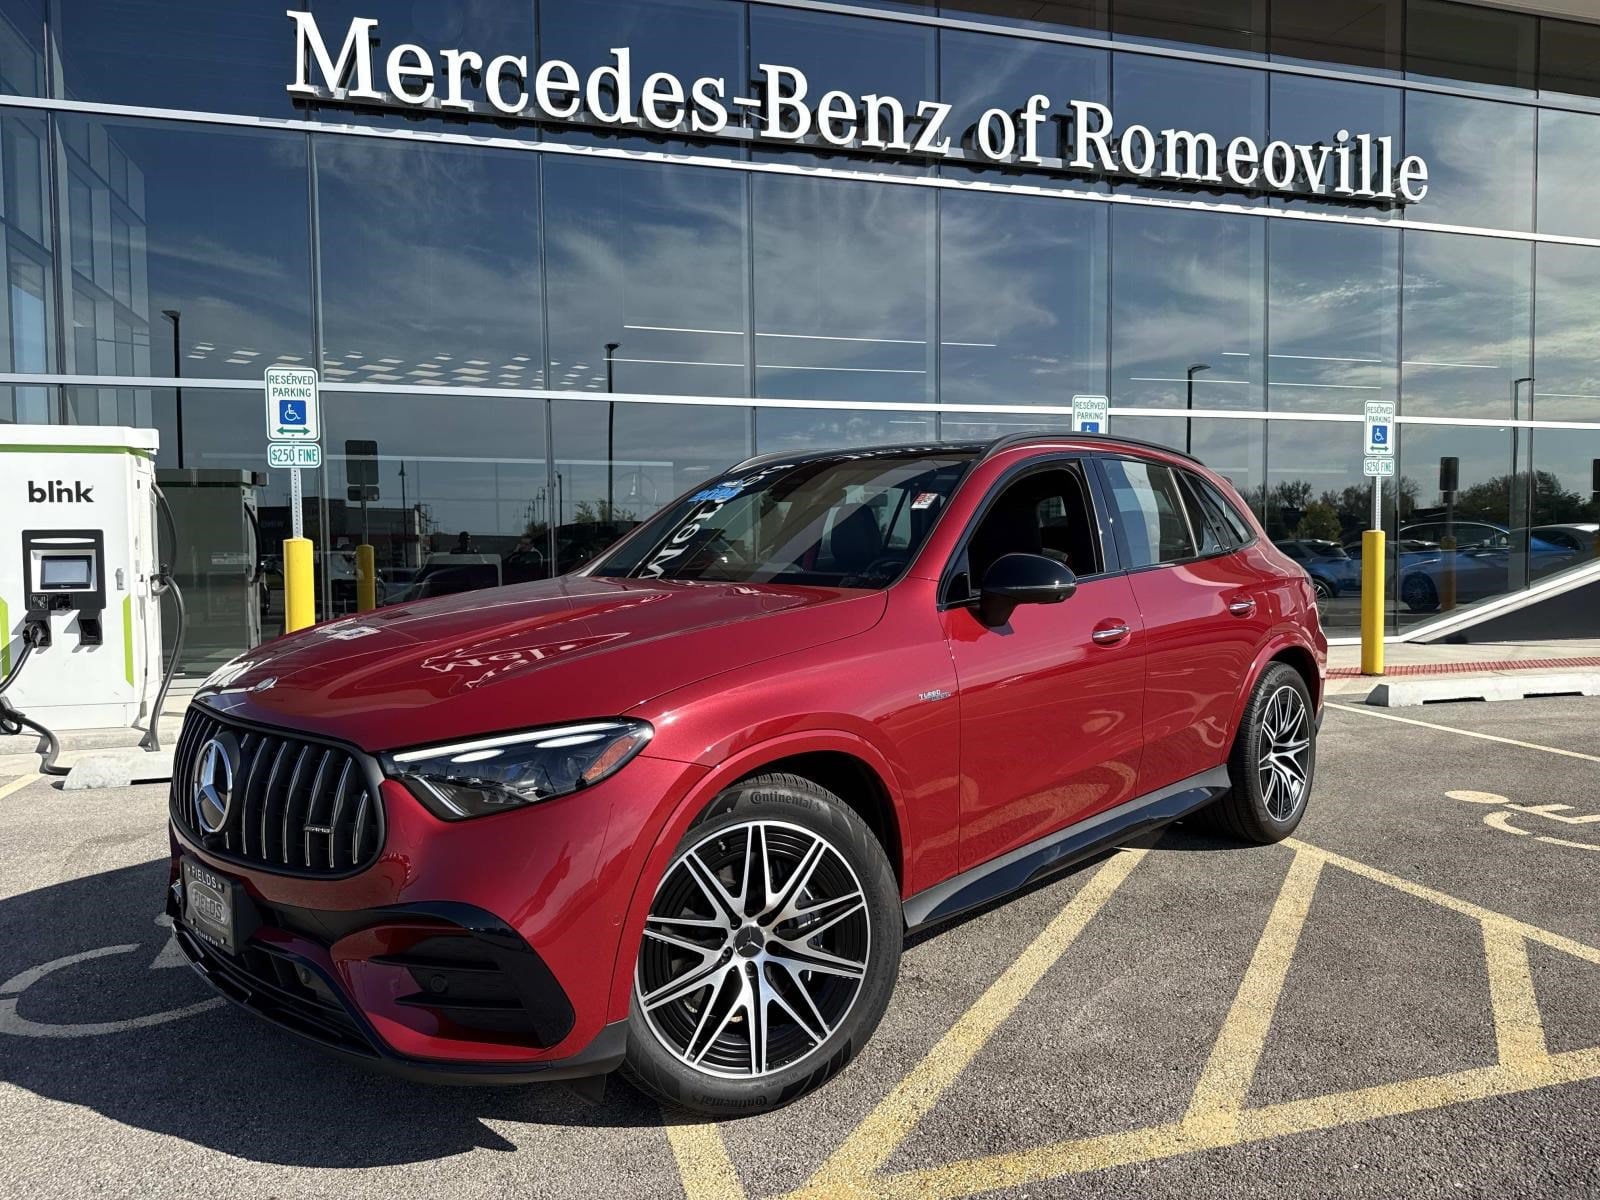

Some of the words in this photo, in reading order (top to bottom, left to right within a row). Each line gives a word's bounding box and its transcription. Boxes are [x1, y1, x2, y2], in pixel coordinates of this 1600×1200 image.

[286, 10, 952, 154] Mercedes-Benz
[978, 94, 1050, 163] of
[1068, 99, 1429, 202] Romeoville
[269, 375, 314, 385] RESERVED
[272, 387, 312, 397] PARKING
[1075, 401, 1106, 410] RESERVED
[1367, 406, 1393, 415] RESERVED
[1077, 411, 1104, 420] PARKING
[1368, 415, 1391, 423] PARKING
[271, 448, 295, 462] $250
[298, 448, 317, 462] FINE
[1366, 461, 1380, 472] $250
[1381, 461, 1393, 472] FINE
[28, 480, 94, 503] blink
[750, 791, 813, 809] Continental
[191, 865, 217, 889] FIELDS
